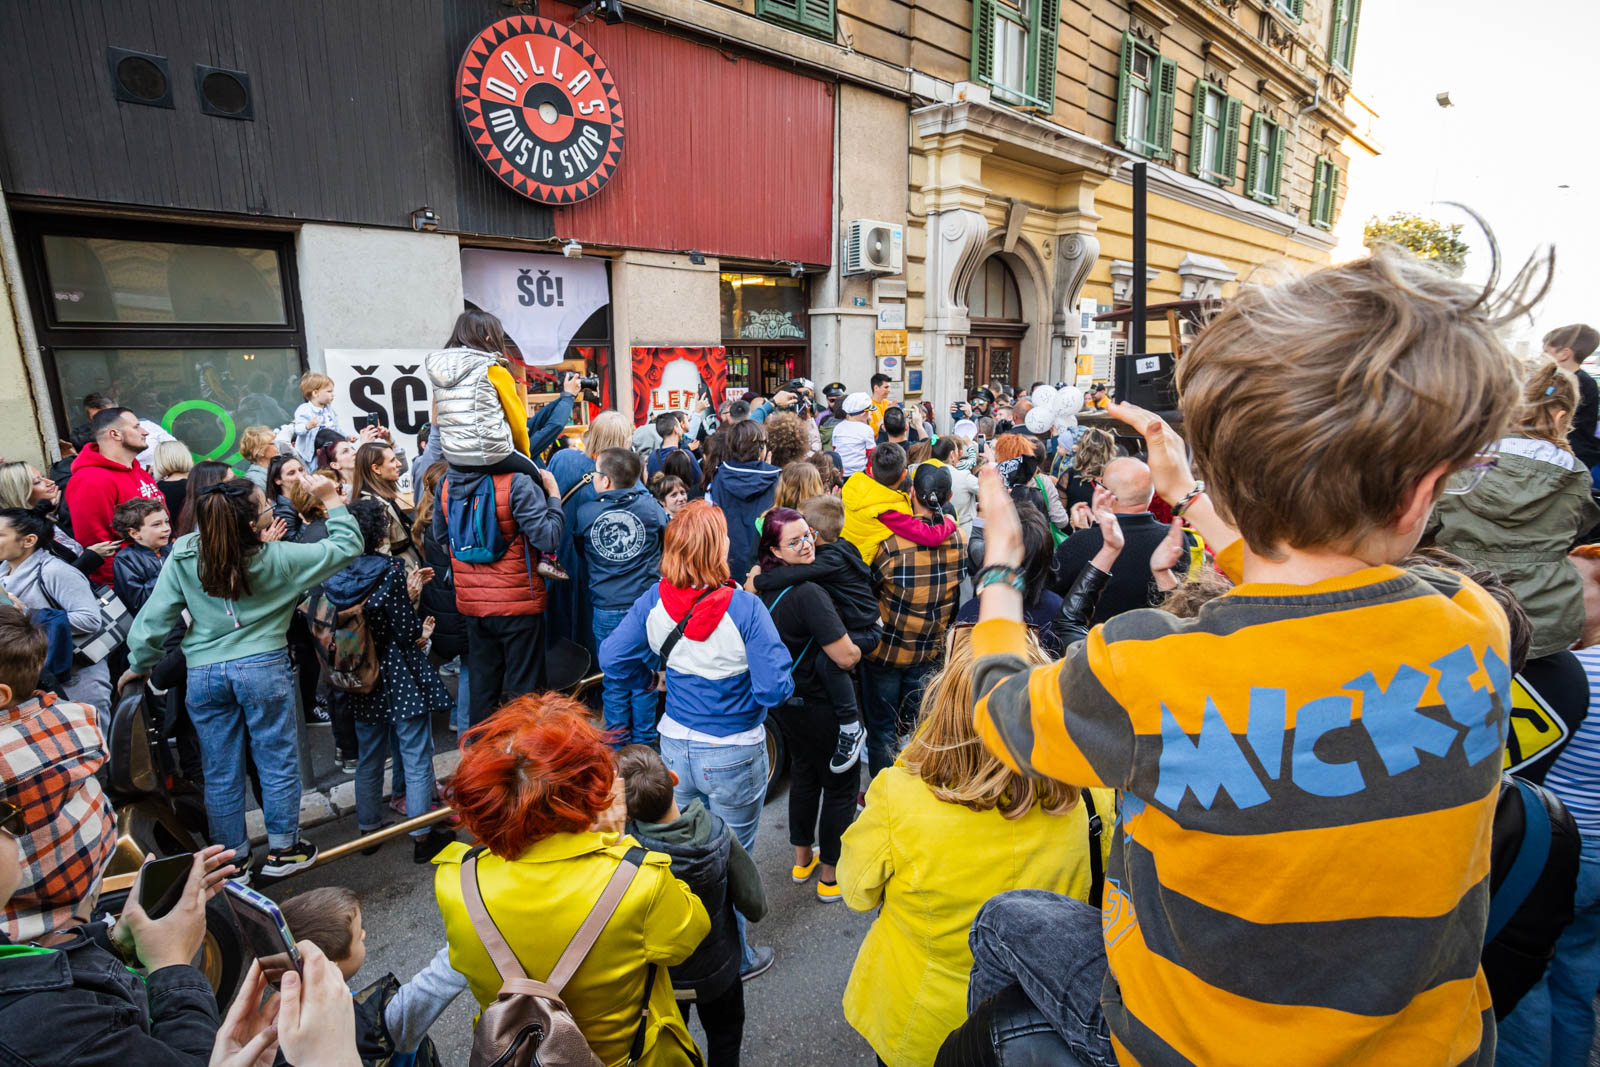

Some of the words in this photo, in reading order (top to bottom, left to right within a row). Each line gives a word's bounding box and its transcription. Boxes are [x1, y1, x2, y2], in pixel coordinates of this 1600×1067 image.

[486, 41, 605, 115] DALLAS
[489, 108, 553, 178] MUSIC
[559, 125, 604, 179] SHOP
[517, 268, 564, 307] ŠČ!
[652, 389, 695, 411] LET
